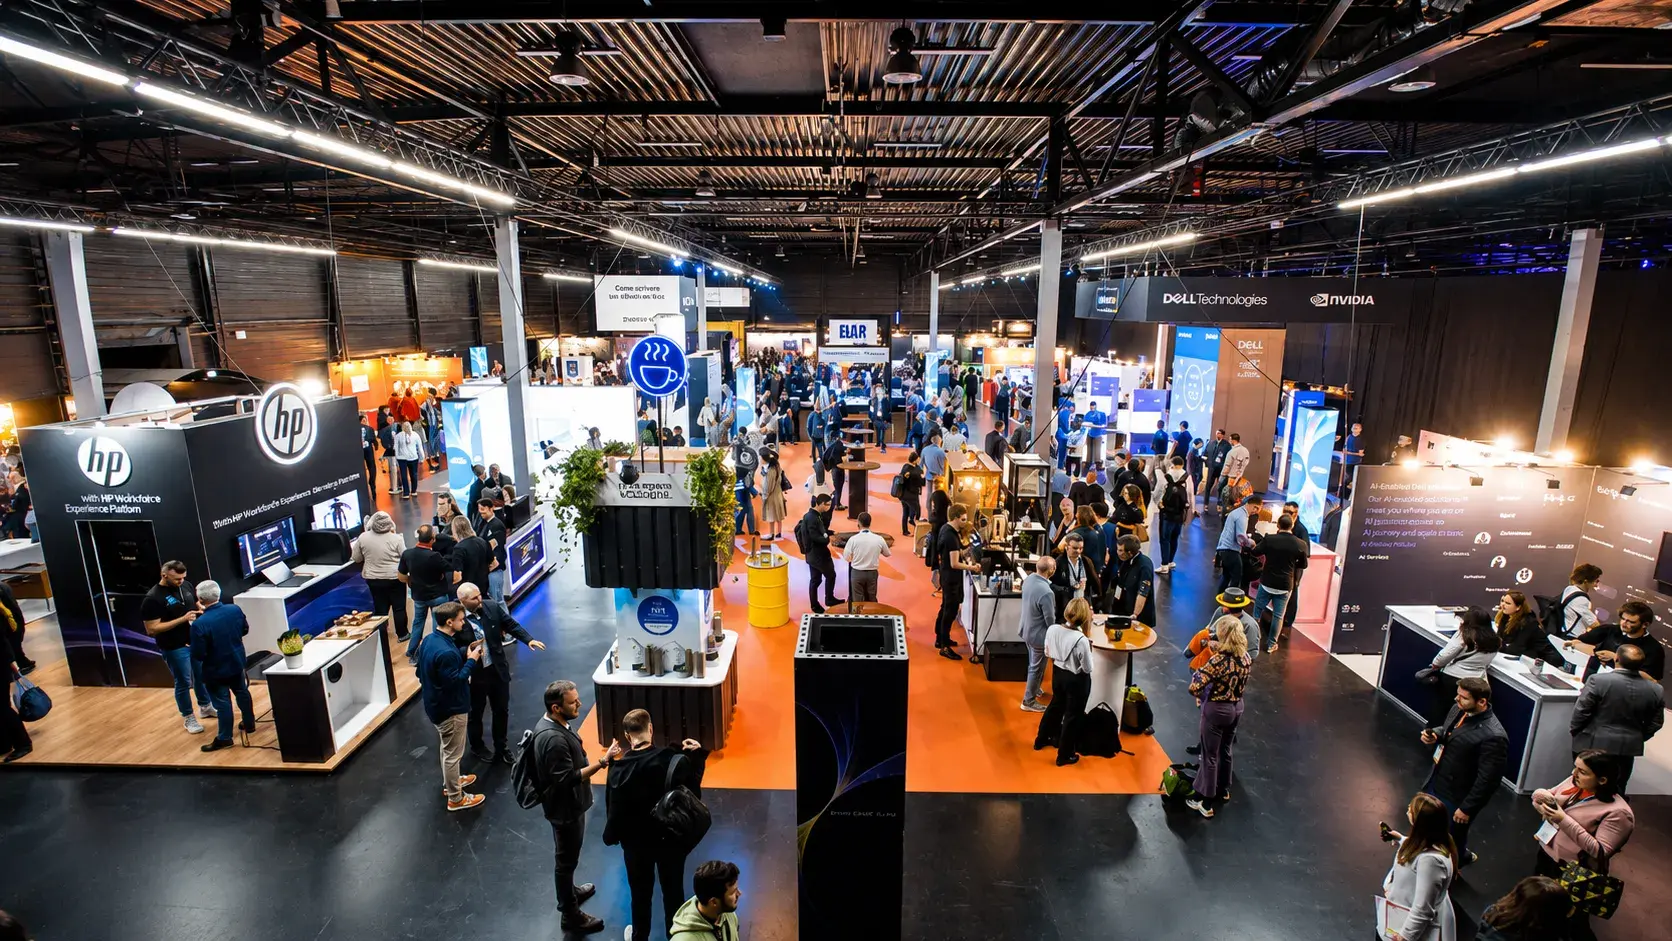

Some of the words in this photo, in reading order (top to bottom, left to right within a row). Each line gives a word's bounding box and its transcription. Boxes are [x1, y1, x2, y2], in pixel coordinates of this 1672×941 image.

[1163, 293, 1196, 304] DELL
[1196, 293, 1268, 308] Technologies
[272, 393, 307, 456] hp
[85, 436, 125, 488] hp
[101, 494, 114, 502] HP
